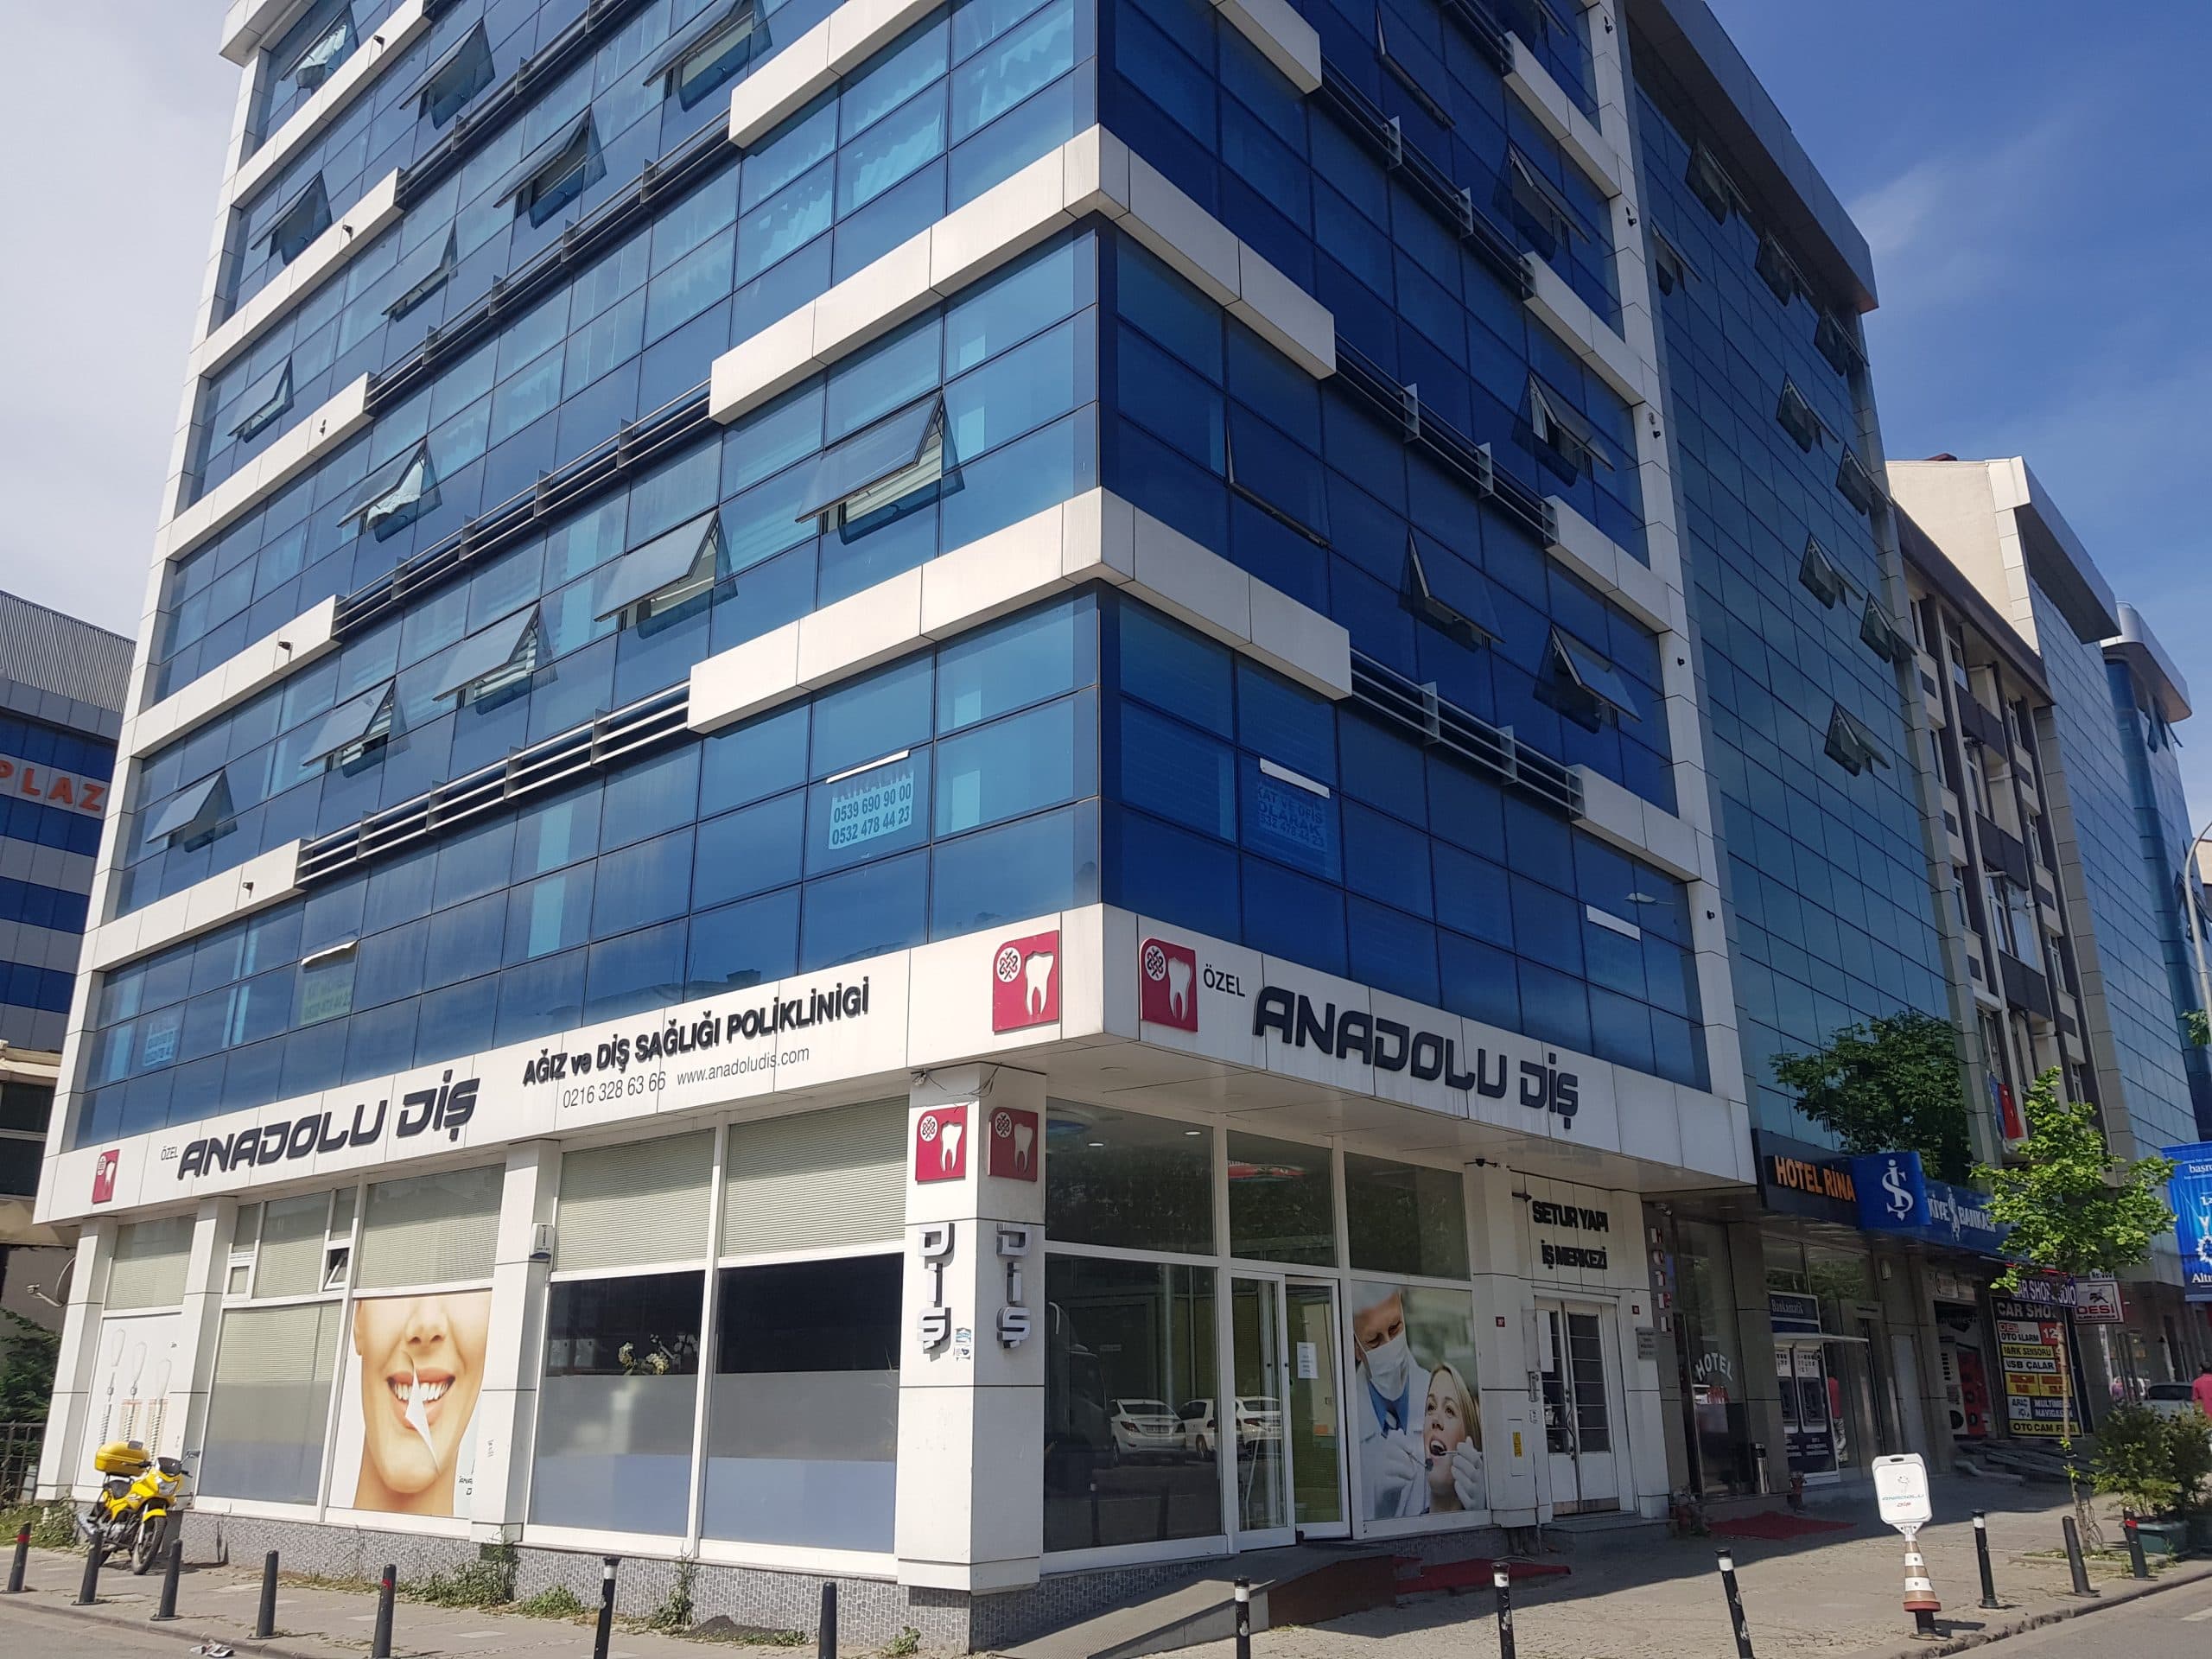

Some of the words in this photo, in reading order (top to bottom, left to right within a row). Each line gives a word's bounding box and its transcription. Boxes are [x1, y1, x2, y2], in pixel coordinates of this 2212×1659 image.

[0, 760, 105, 811] PLAZ
[834, 801, 859, 823] 0539
[861, 794, 880, 815] 690
[883, 788, 896, 807] 90
[899, 783, 912, 799] 00
[832, 823, 858, 845] 0532
[861, 817, 880, 836] 478
[883, 810, 896, 830] 44
[898, 805, 910, 824] 23
[523, 1048, 567, 1086] AĞIZ
[570, 1052, 591, 1076] ve
[596, 1033, 629, 1074] DİŞ
[635, 1009, 721, 1063] SAĞLIĞI
[1203, 963, 1246, 998] ÖZEL
[1253, 985, 1507, 1099] ANADOLU
[1519, 1052, 1579, 1129] DİŞ
[563, 1086, 594, 1109] 0216
[598, 1080, 624, 1102] 328
[626, 1077, 645, 1096] 63
[647, 1071, 666, 1092] 66
[677, 1046, 810, 1086] www.anadoludis.com
[161, 1145, 179, 1161] ÖZEL
[177, 1099, 388, 1180] ANADOLU
[396, 1070, 480, 1143] DİŞ
[1775, 1155, 1823, 1194] HOTEL
[1532, 1199, 1580, 1231] SETUR
[1580, 1205, 1609, 1234] YAPI
[1554, 1244, 1608, 1271] MERKEZİ
[1997, 1302, 2024, 1317] CAR
[2026, 1304, 2057, 1319] SHO
[2001, 1332, 2018, 1341] OTO
[1695, 1352, 1733, 1382] HOTEL
[2005, 1360, 2024, 1370] USB
[2026, 1361, 2055, 1371] ÇALAR
[2013, 1422, 2032, 1432] OTO
[2034, 1423, 2054, 1433] CAM
